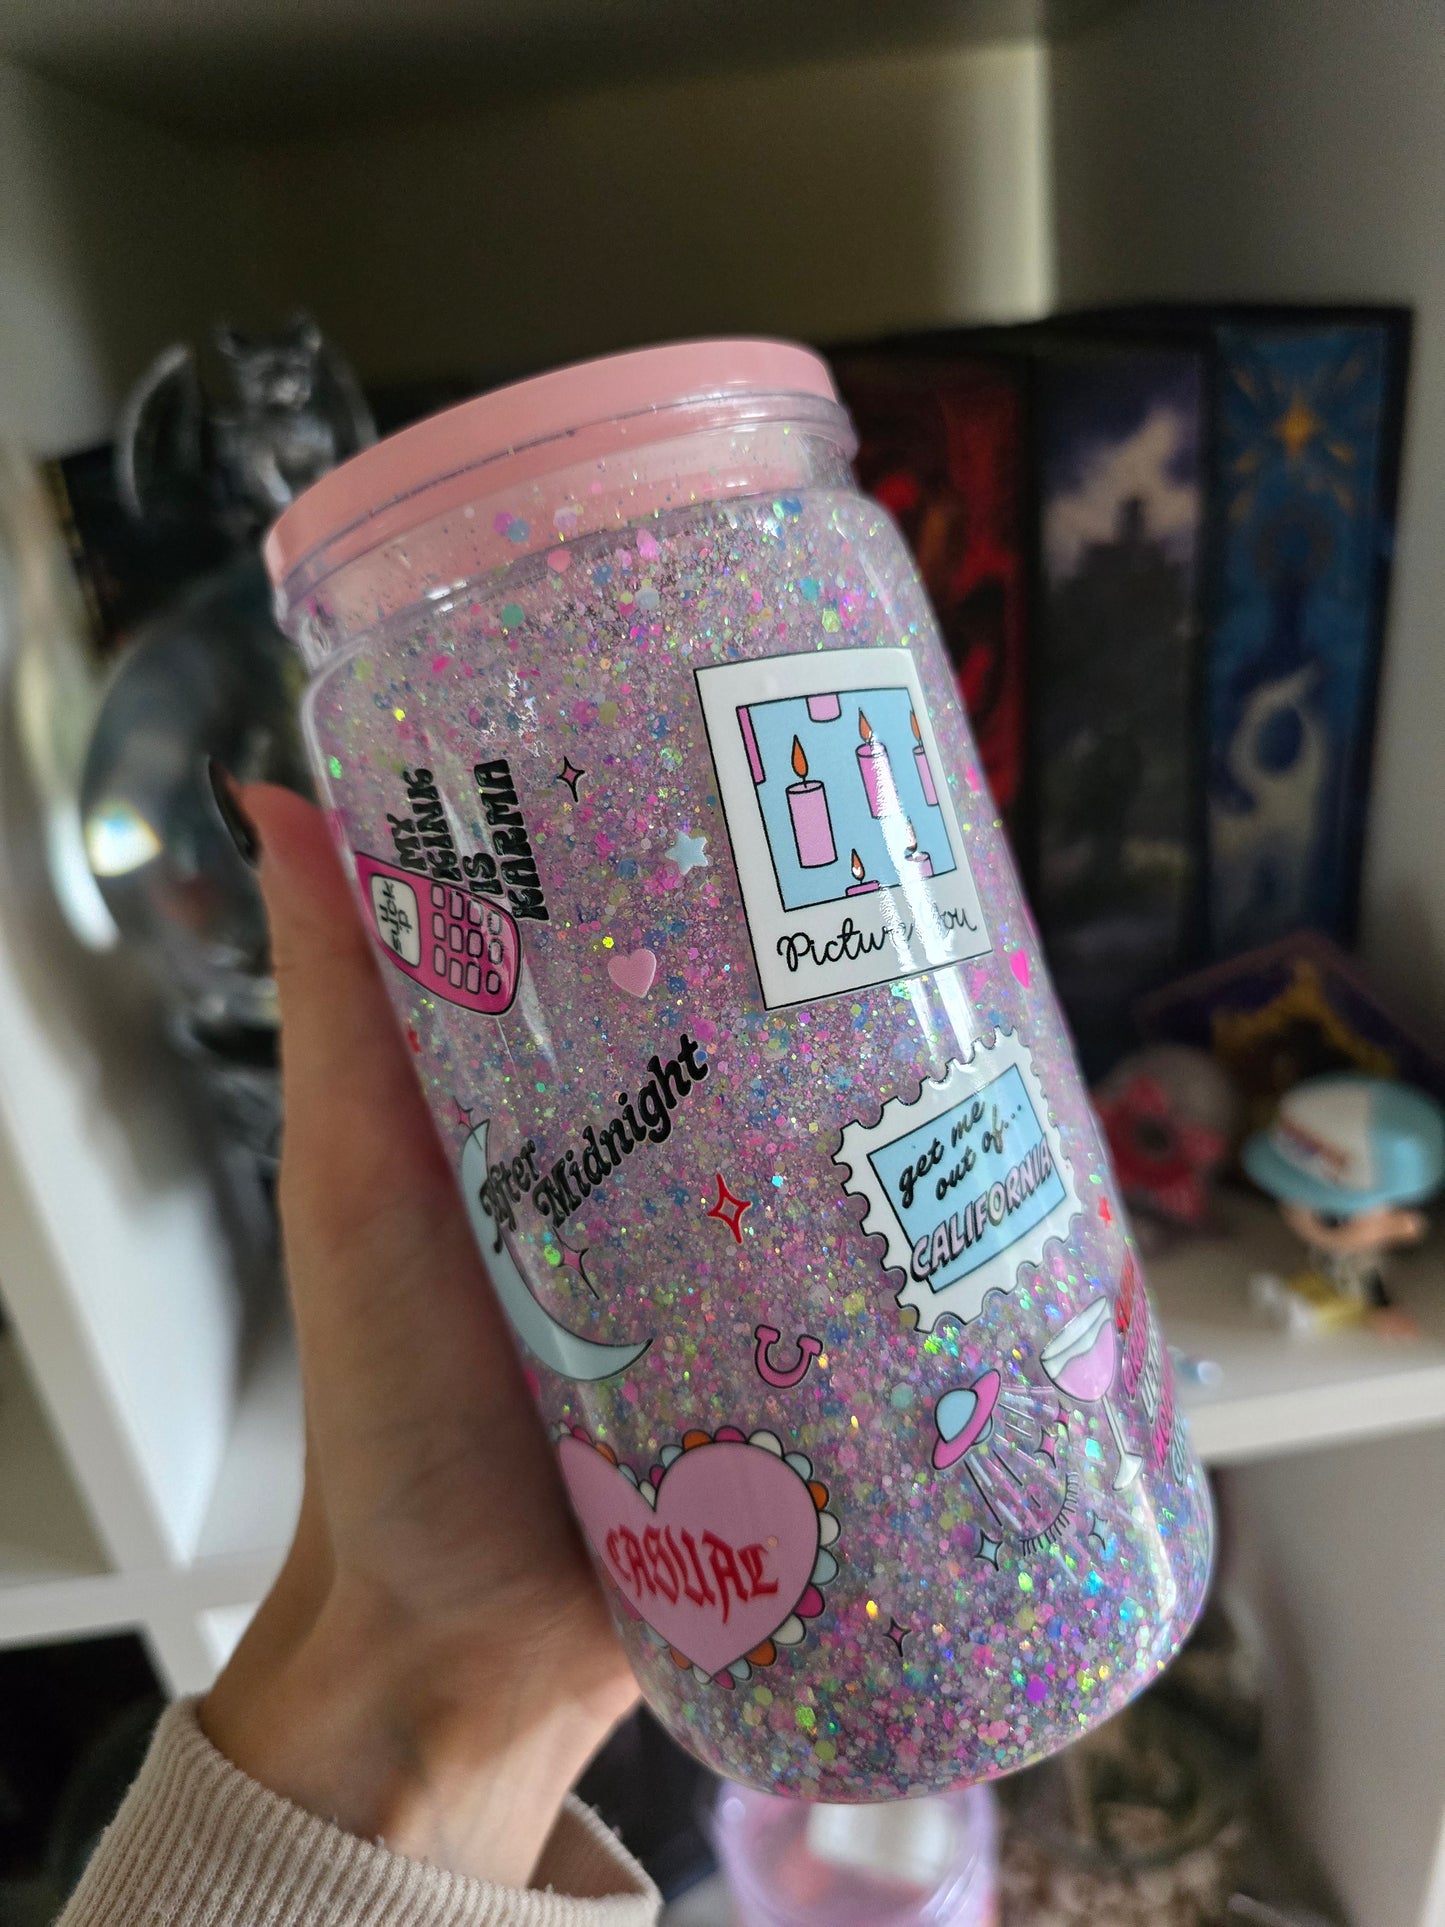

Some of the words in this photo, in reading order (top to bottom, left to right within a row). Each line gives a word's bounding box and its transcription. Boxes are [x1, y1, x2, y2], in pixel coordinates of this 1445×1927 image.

[386, 813, 427, 871] MY
[403, 768, 463, 882] KINK
[462, 852, 504, 895] IS
[473, 758, 549, 921] KARMA
[532, 1033, 709, 1228] Midnight
[899, 1137, 944, 1209] get
[951, 1101, 985, 1147] me
[935, 1146, 976, 1201] out
[479, 1139, 540, 1254] After
[910, 1133, 1051, 1282] CALIFORNIA
[606, 1523, 779, 1625] CASUAL
